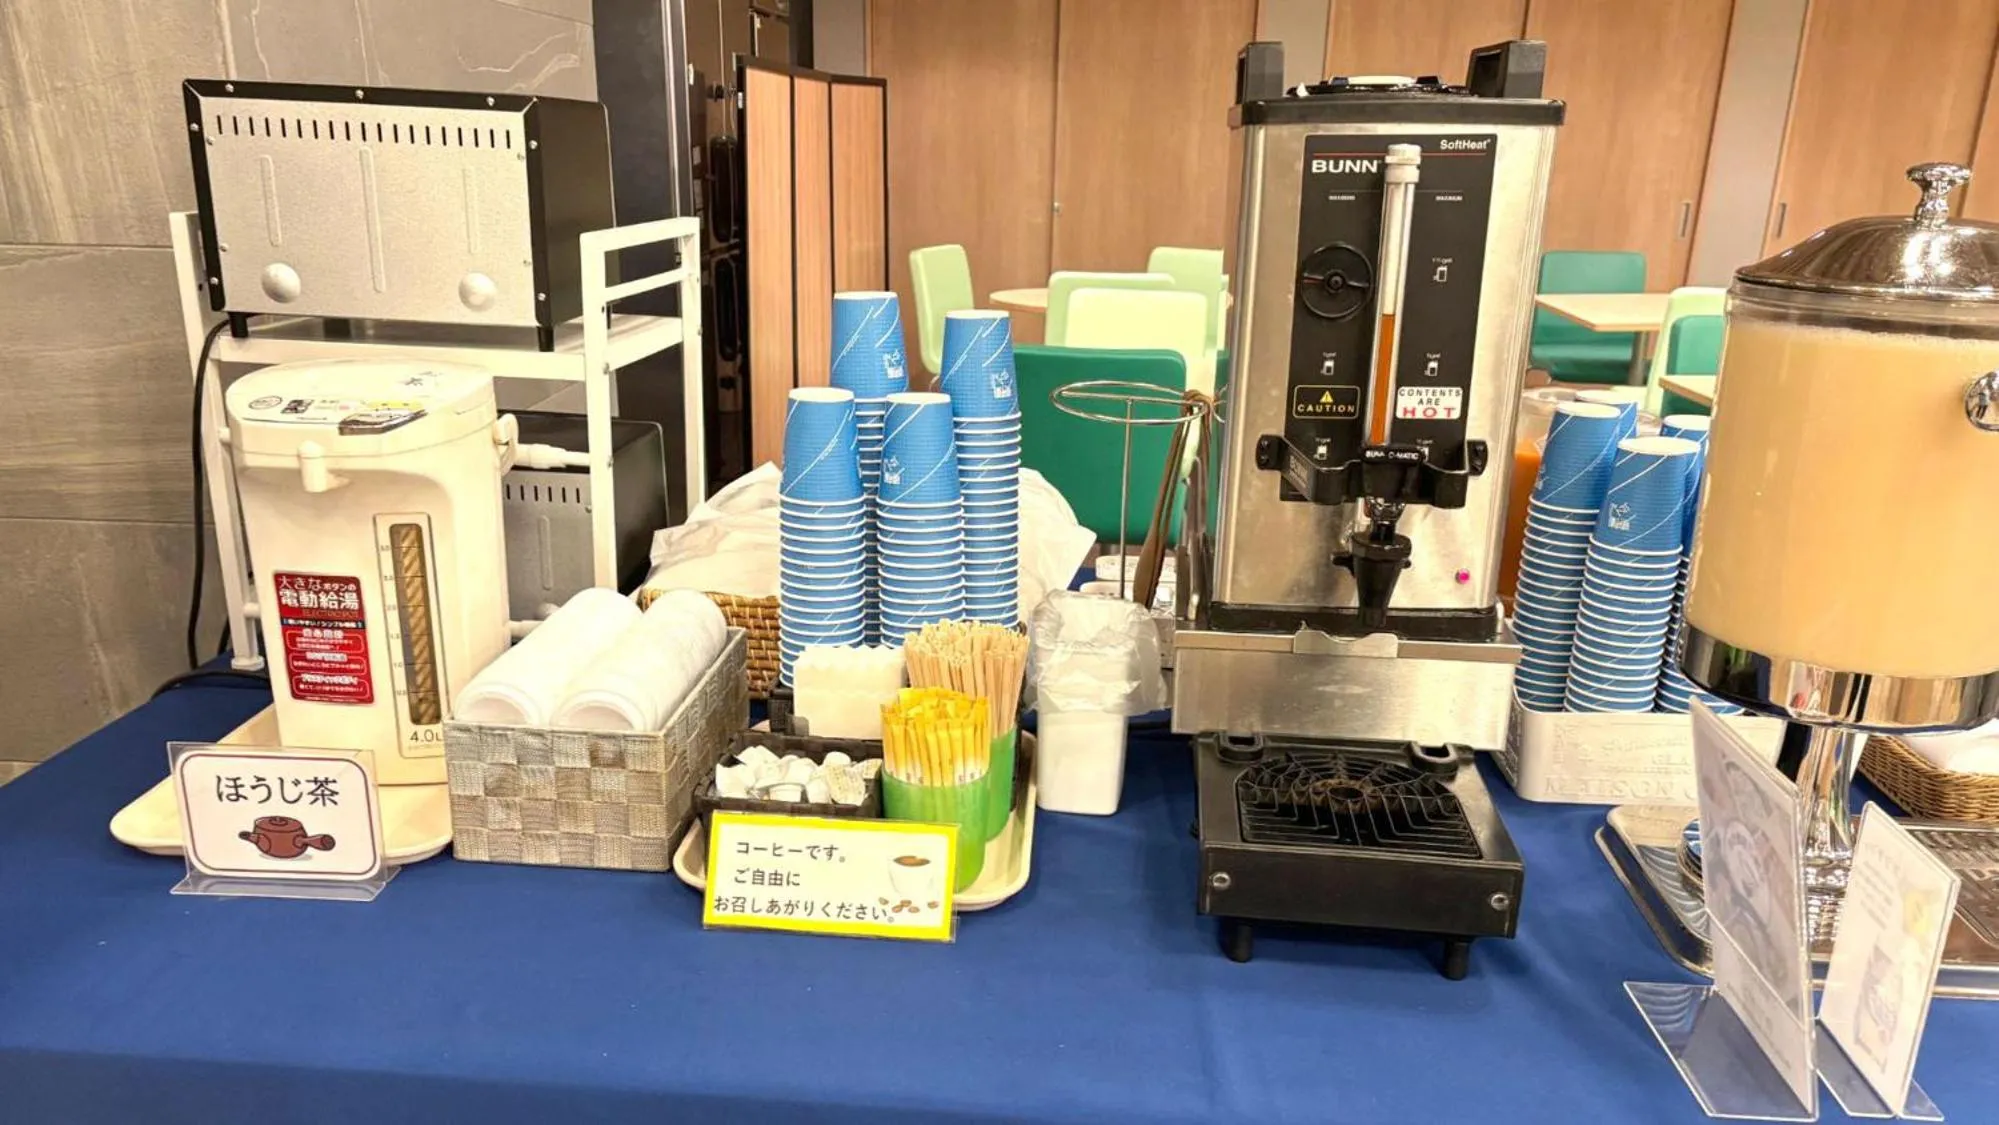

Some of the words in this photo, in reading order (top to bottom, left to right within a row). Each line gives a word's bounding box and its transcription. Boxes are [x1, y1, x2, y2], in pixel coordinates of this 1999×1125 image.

[1311, 160, 1378, 173] BUNN
[1399, 388, 1461, 397] CONTENTS
[1297, 404, 1355, 413] CAUTION
[1417, 398, 1441, 406] ARE
[1402, 406, 1456, 419] HOT
[279, 588, 360, 610] 電動給湯
[216, 774, 340, 807] ほうじ茶
[736, 841, 846, 863] コーヒーです。
[734, 868, 801, 887] ご自由に
[713, 895, 895, 924] お召しあがりください。
